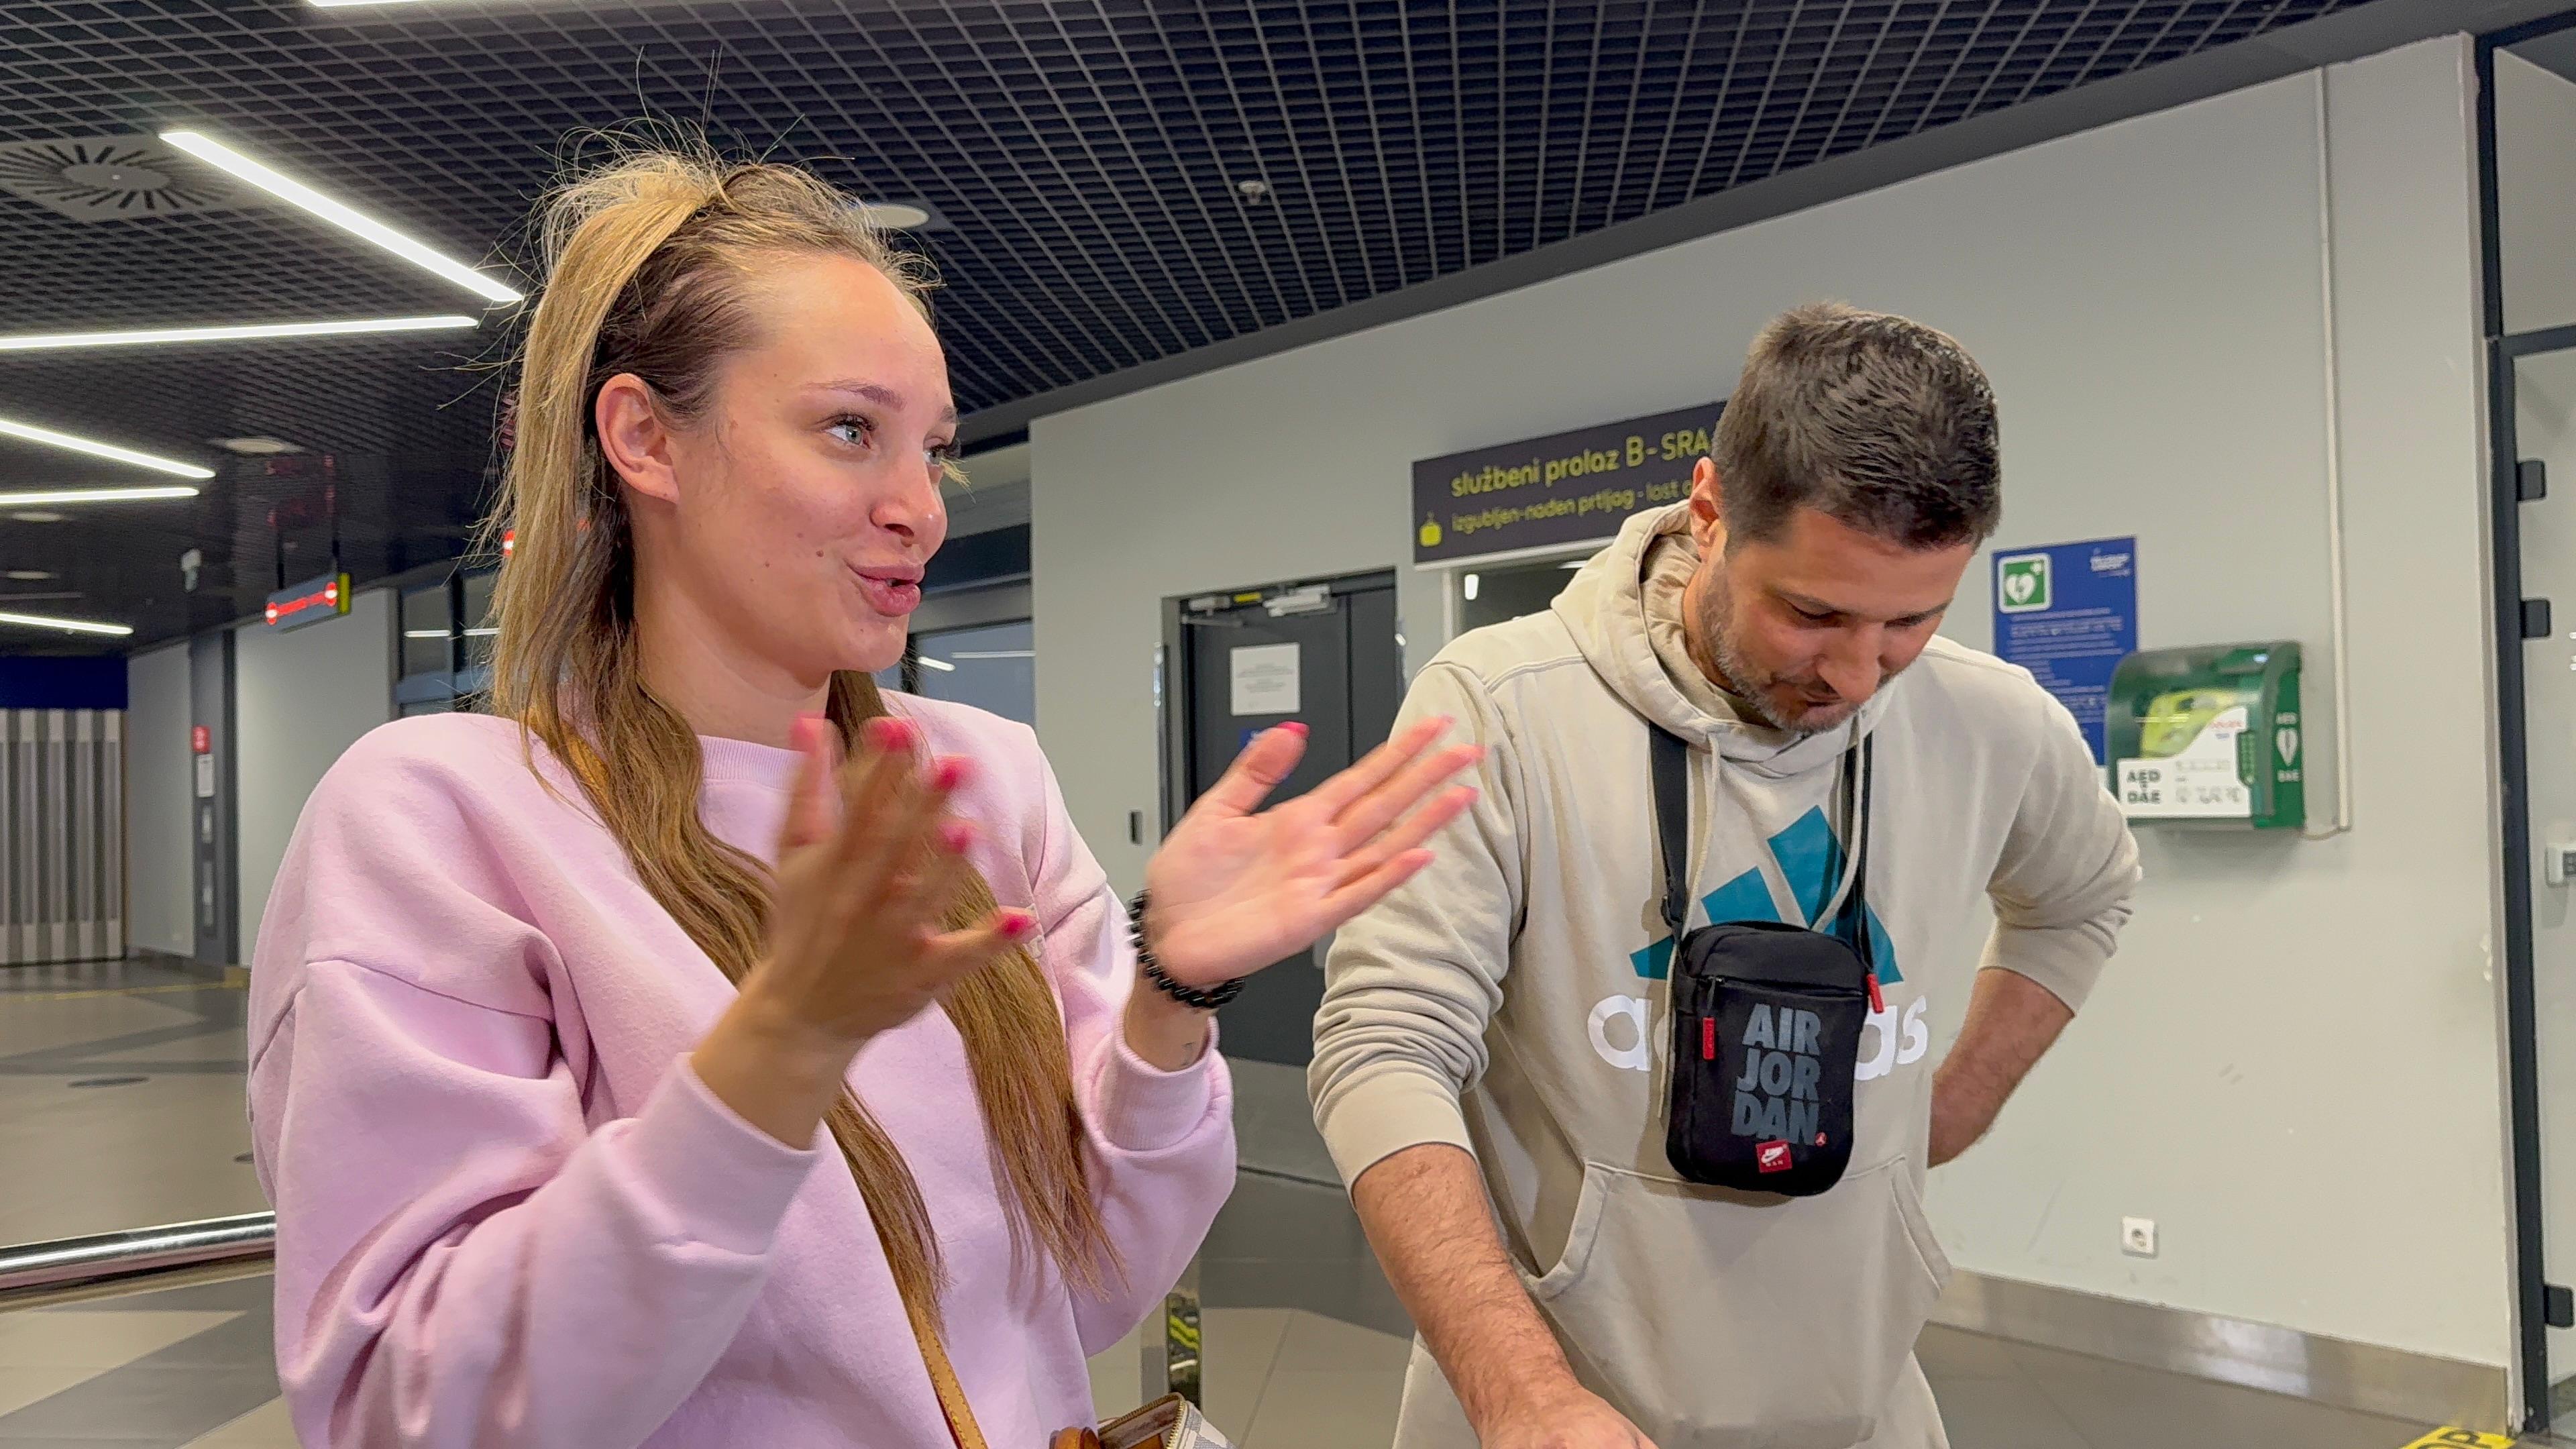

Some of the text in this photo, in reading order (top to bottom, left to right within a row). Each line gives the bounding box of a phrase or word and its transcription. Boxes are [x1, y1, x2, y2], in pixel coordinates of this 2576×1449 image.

[1451, 457, 1540, 497] službeni
[1545, 449, 1621, 488] prolaz
[1588, 994, 1928, 1081] aas
[1742, 1003, 1821, 1056] AIR
[1736, 1048, 1821, 1102] JOR
[1730, 1089, 1820, 1146] DAN
